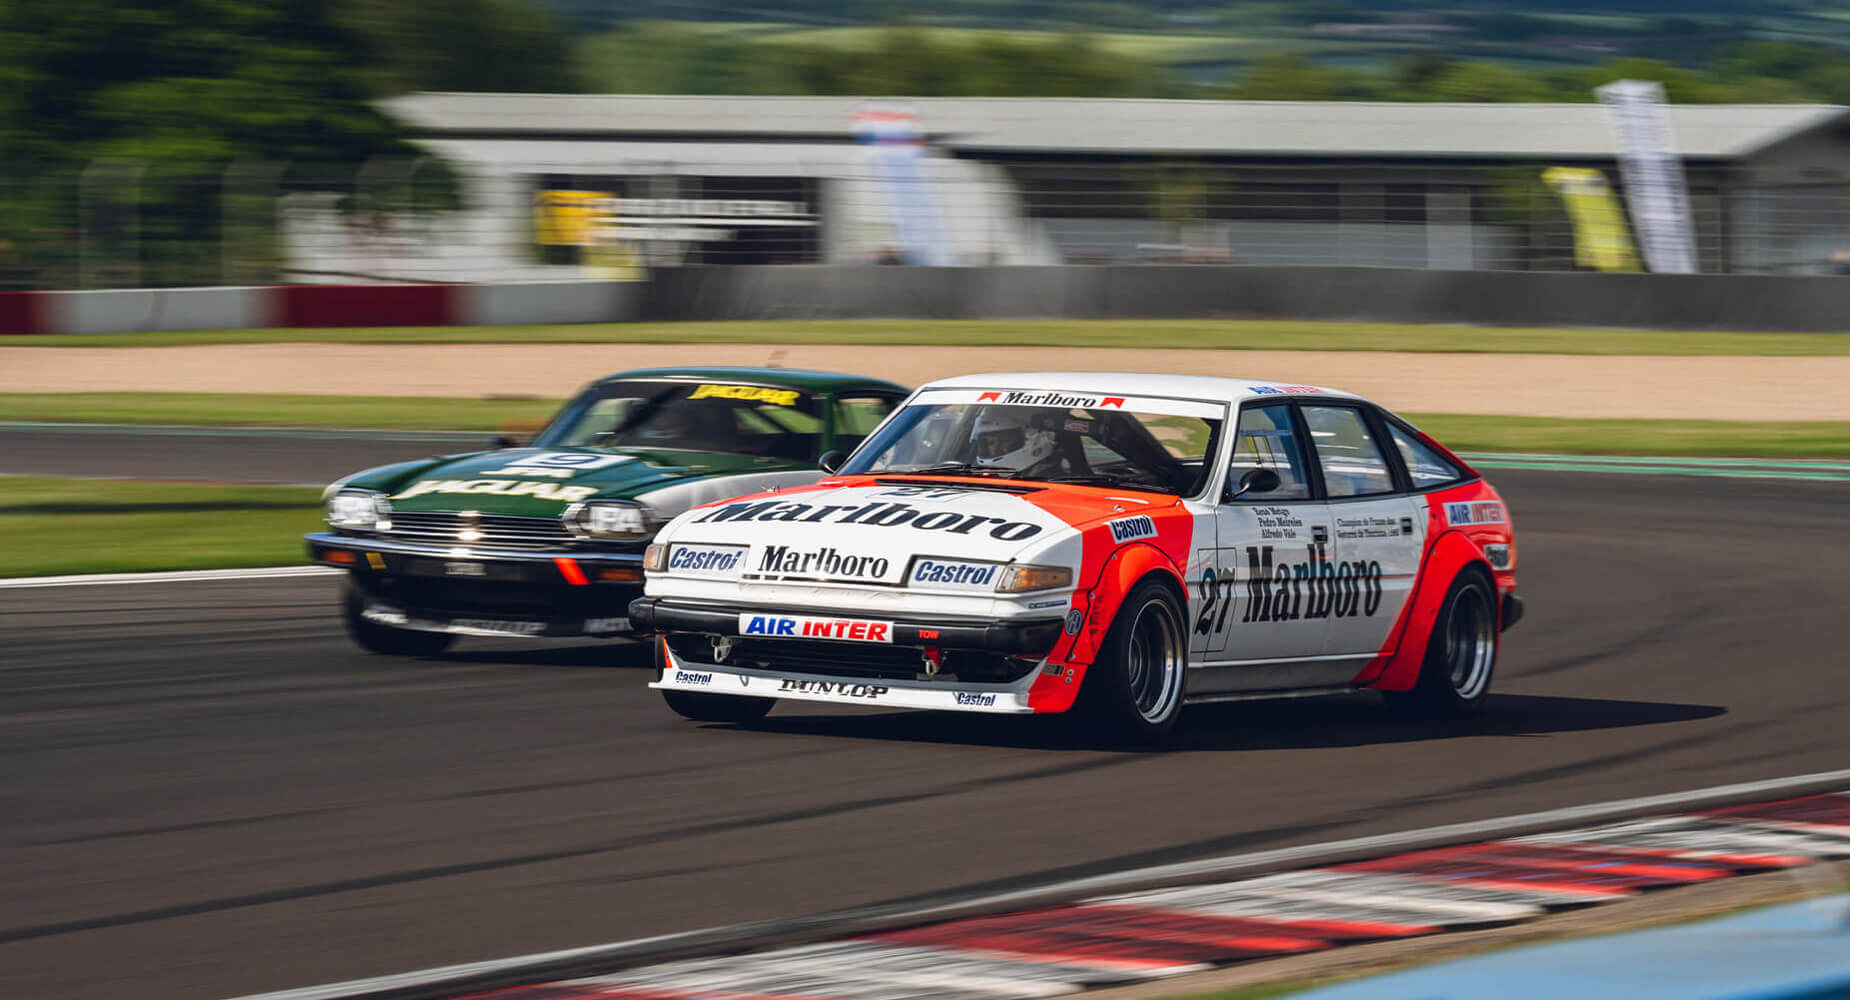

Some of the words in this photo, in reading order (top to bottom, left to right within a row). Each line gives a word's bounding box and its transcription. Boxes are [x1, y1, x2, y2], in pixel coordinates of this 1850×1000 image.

[687, 384, 800, 406] JAGUAR
[1002, 392, 1096, 408] Marlboro
[535, 454, 602, 466] 9
[388, 480, 600, 502] JAGUAR
[691, 500, 1043, 541] Marlboro
[1258, 517, 1277, 527] Pedro
[1449, 503, 1473, 525] AIR
[1109, 515, 1154, 541] Castrol
[669, 547, 743, 571] Castrol
[758, 545, 889, 578] Marlboro
[915, 560, 998, 585] Castrol
[1242, 543, 1382, 623] Marlboro
[1194, 566, 1236, 636] 27
[746, 616, 797, 635] AIR
[802, 619, 888, 641] INTER
[918, 629, 940, 640] TOW
[675, 671, 712, 686] Castrol
[778, 678, 889, 699] DUNLOP
[957, 692, 997, 707] Castrol
